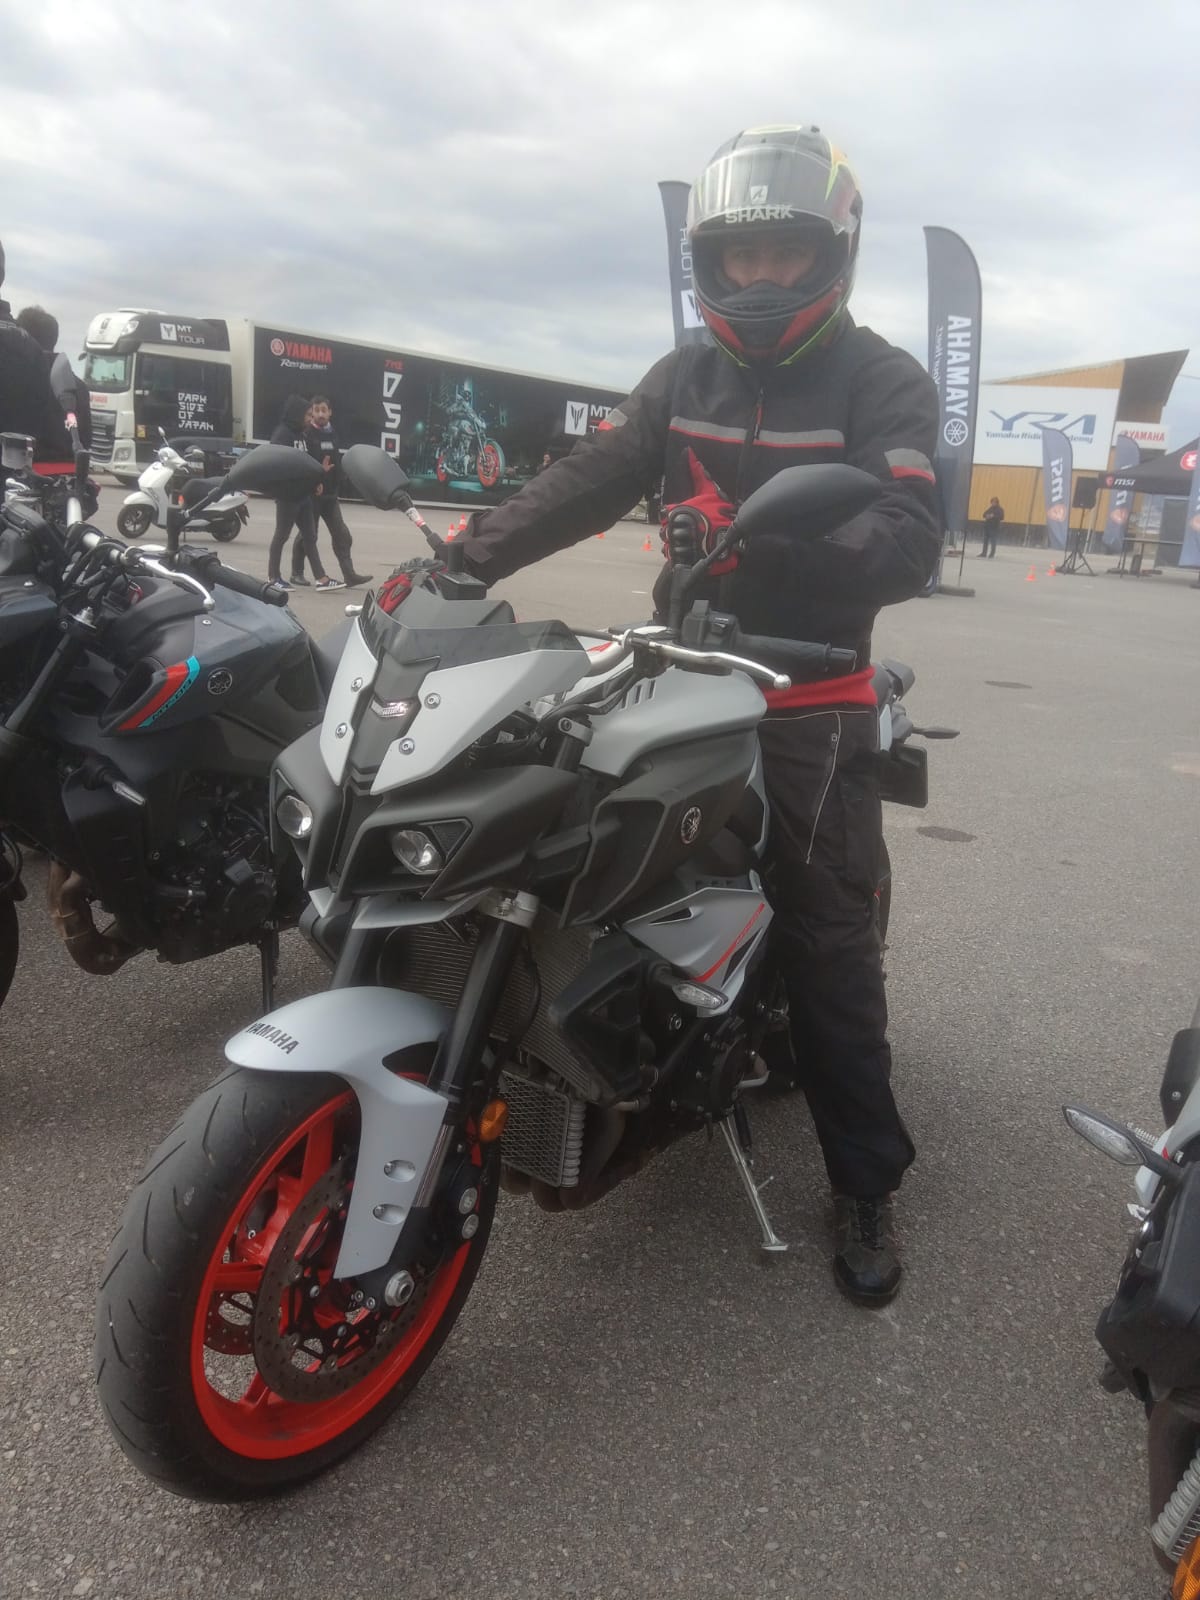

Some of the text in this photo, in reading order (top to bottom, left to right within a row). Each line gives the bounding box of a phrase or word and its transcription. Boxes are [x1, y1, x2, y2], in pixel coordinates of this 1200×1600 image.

[725, 204, 794, 224] SHARK
[177, 324, 192, 333] MT
[179, 335, 205, 345] TOUR
[284, 341, 333, 364] YAMAHA
[178, 392, 207, 404] DARK
[178, 401, 205, 413] SIDE
[590, 404, 612, 419] MT
[178, 410, 195, 420] OF
[178, 420, 214, 431] JAPAN
[985, 431, 1020, 440] Yamaha
[1127, 429, 1166, 442] YAMAHA
[1114, 478, 1137, 487] msi
[245, 1022, 300, 1055] YAMAHA
